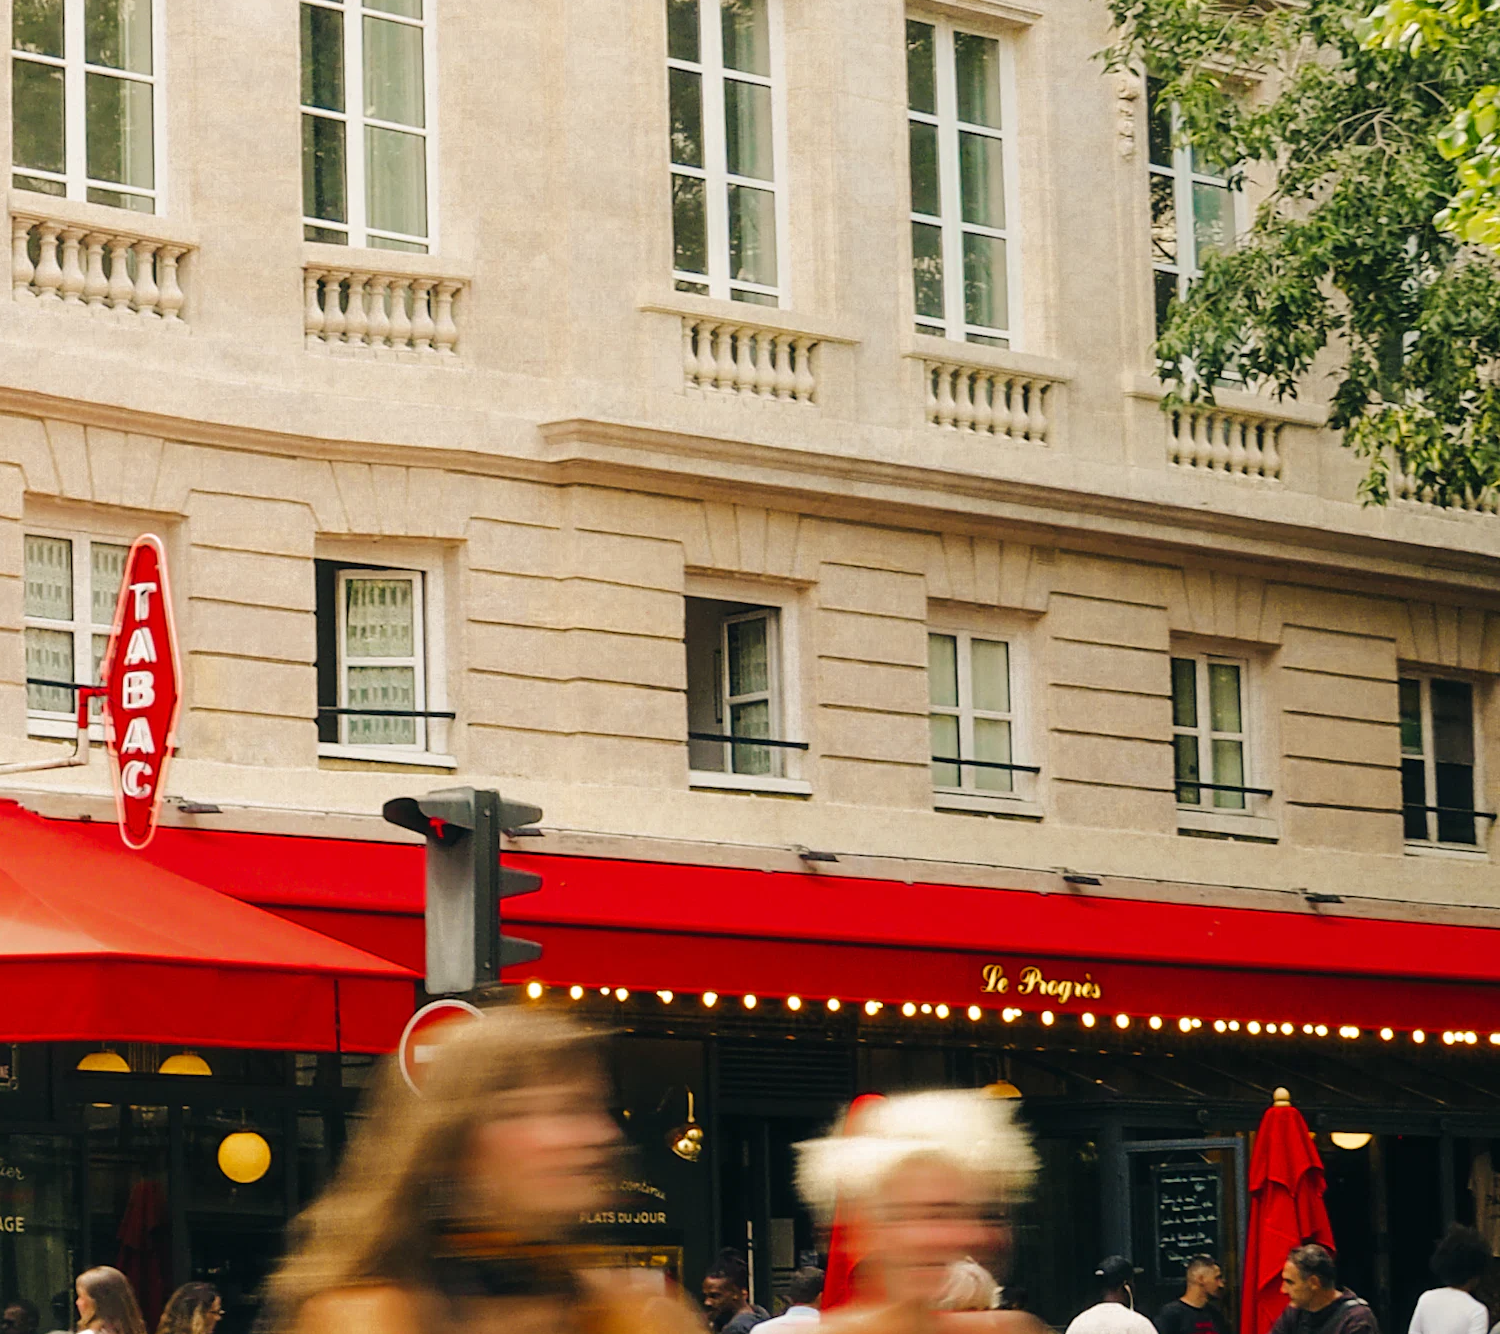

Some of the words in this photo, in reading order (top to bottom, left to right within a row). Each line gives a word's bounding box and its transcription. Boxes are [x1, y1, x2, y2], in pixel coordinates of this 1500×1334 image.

[121, 582, 157, 799] TABAC
[980, 964, 1009, 994] Le
[1017, 966, 1101, 1004] Progrès
[579, 1211, 616, 1224] PLATS
[617, 1212, 632, 1224] DU
[633, 1211, 667, 1224] JOUR
